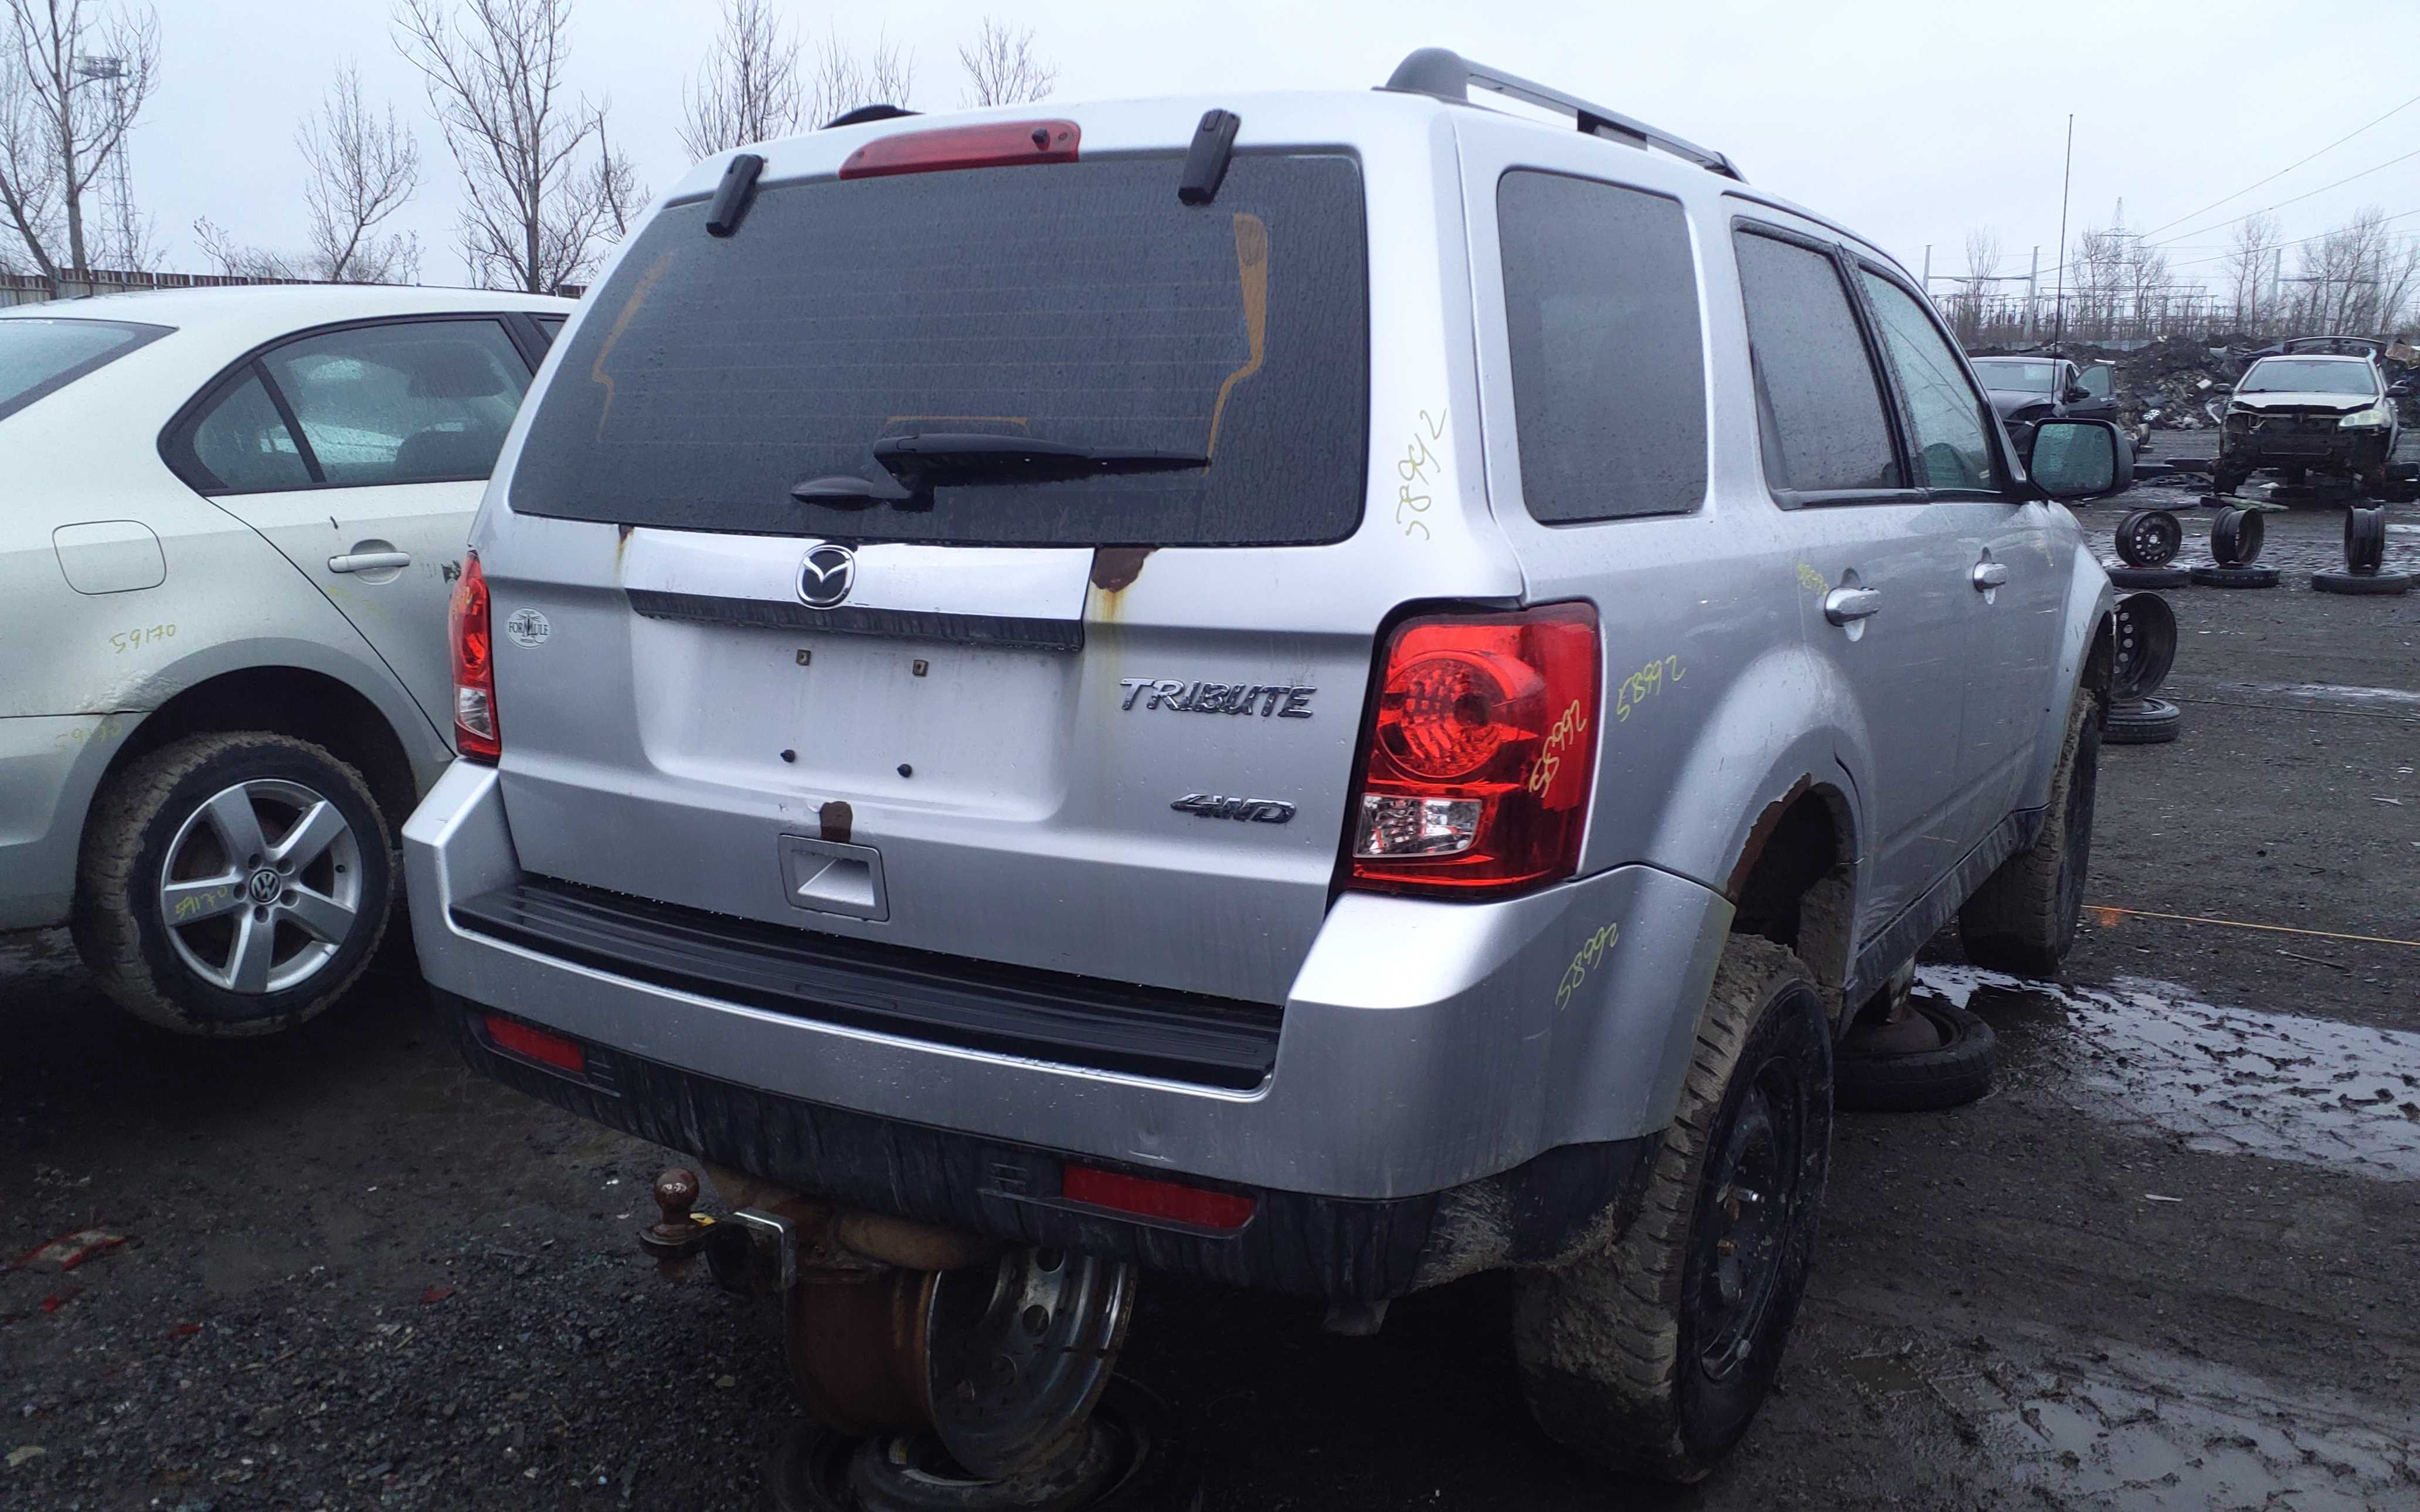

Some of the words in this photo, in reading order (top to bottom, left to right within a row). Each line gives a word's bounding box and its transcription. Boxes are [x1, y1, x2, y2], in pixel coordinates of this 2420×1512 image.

[109, 623, 178, 653] 59170
[1120, 677, 1317, 718] TRIBUTE
[1616, 655, 1687, 722] 58992
[1170, 793, 1297, 823] 4WD
[175, 886, 229, 918] 59170
[1555, 922, 1619, 1010] 58992
